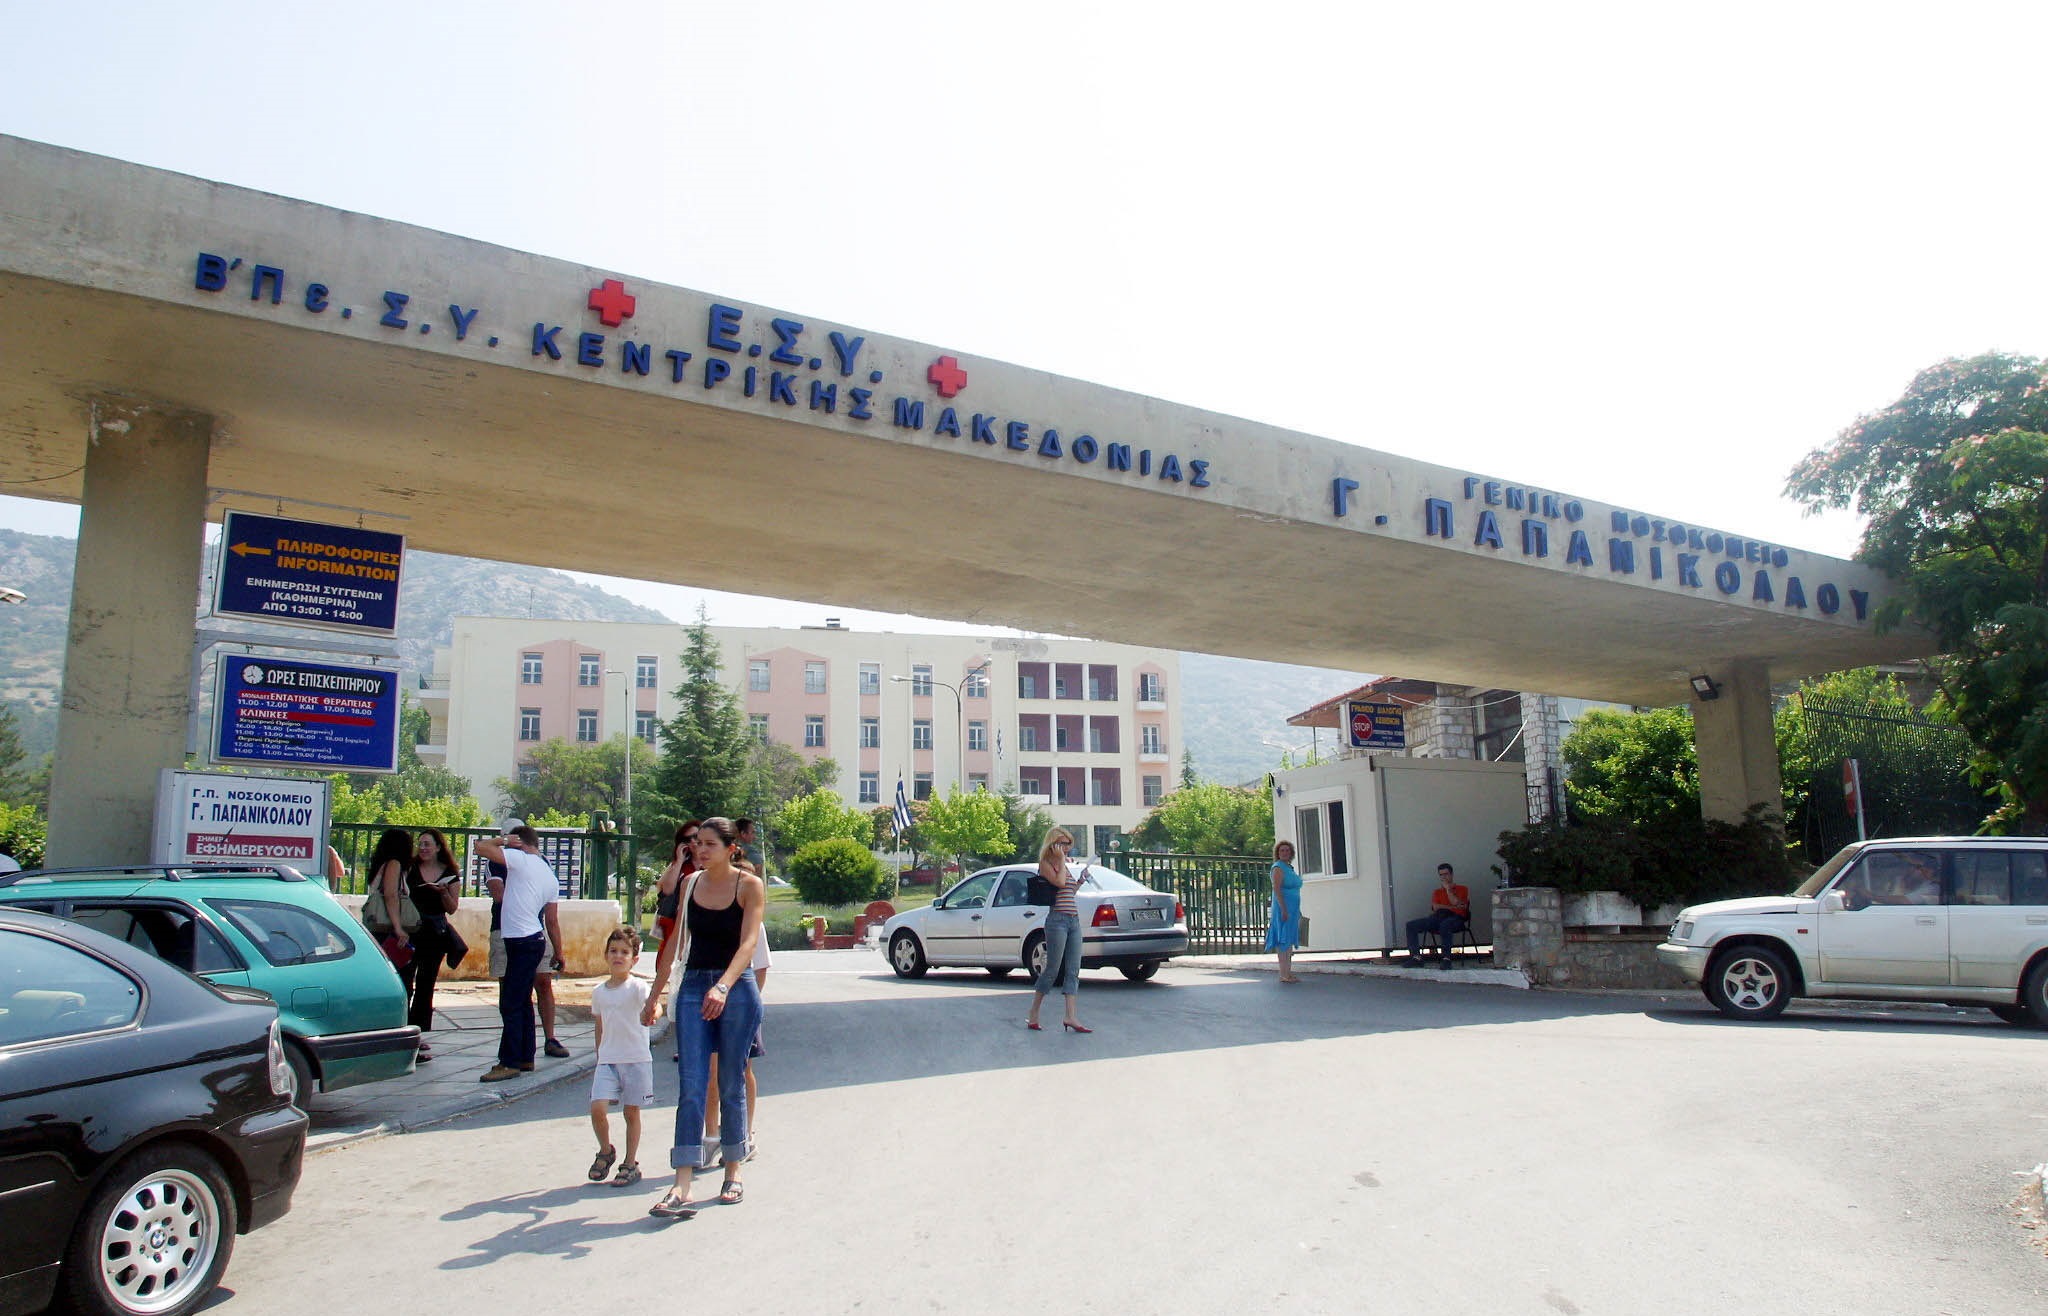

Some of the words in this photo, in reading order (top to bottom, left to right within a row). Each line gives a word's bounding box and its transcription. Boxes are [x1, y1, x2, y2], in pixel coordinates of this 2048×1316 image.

[532, 323, 872, 420] ΚΕΝΤΡΙΚΗΣ
[894, 397, 1210, 488] ΜΑΚΕΔΟΝΙΑΣ
[1464, 477, 1583, 522] ΓΕΝΙΚΟ
[1611, 510, 1788, 568] ΝΟΣΟΚΟΜΕΙΟ
[277, 539, 400, 566] ΠΛΗΡΟΦΟΡΙΕΣ
[1426, 498, 1868, 621] ΠΑΠΑΝΙΚΟΛΑΟΥ
[277, 556, 396, 581] INFORMATION
[246, 577, 320, 593] ΕΝΗΜΕΡΩΣΗ
[323, 585, 383, 600] ΣΥΓΓΕΝΩΝ
[272, 591, 356, 609] (ΚΑΘΗΜΕΡΙΝΑ)
[262, 602, 287, 612] ΑΠΟ
[291, 605, 322, 616] 13:00
[333, 609, 363, 621] 14:00
[267, 669, 296, 685] ΩΡΕΣ
[299, 672, 381, 694] ΕΠΙΣΚΕΠΤΗΡΙΟΥ
[270, 693, 319, 704] ΕΝΤΑΤΙΚΗΣ
[323, 697, 372, 709] ΘΕΡΑΠΕΙΑΣ
[240, 708, 288, 719] ΚΛΙΝΙΚΕΣ
[1354, 722, 1370, 732] STOP
[193, 788, 219, 798] Γ.Π.
[228, 790, 312, 804] ΝΟΣΟΚΟΜΕΙΟ
[192, 803, 203, 821] Γ.
[212, 803, 312, 826] ΠΑΠΑΝΙΚΟΛΑΟΥ
[196, 842, 306, 857] ΕΦΗΜΕΡΕΥΟΥΝ
